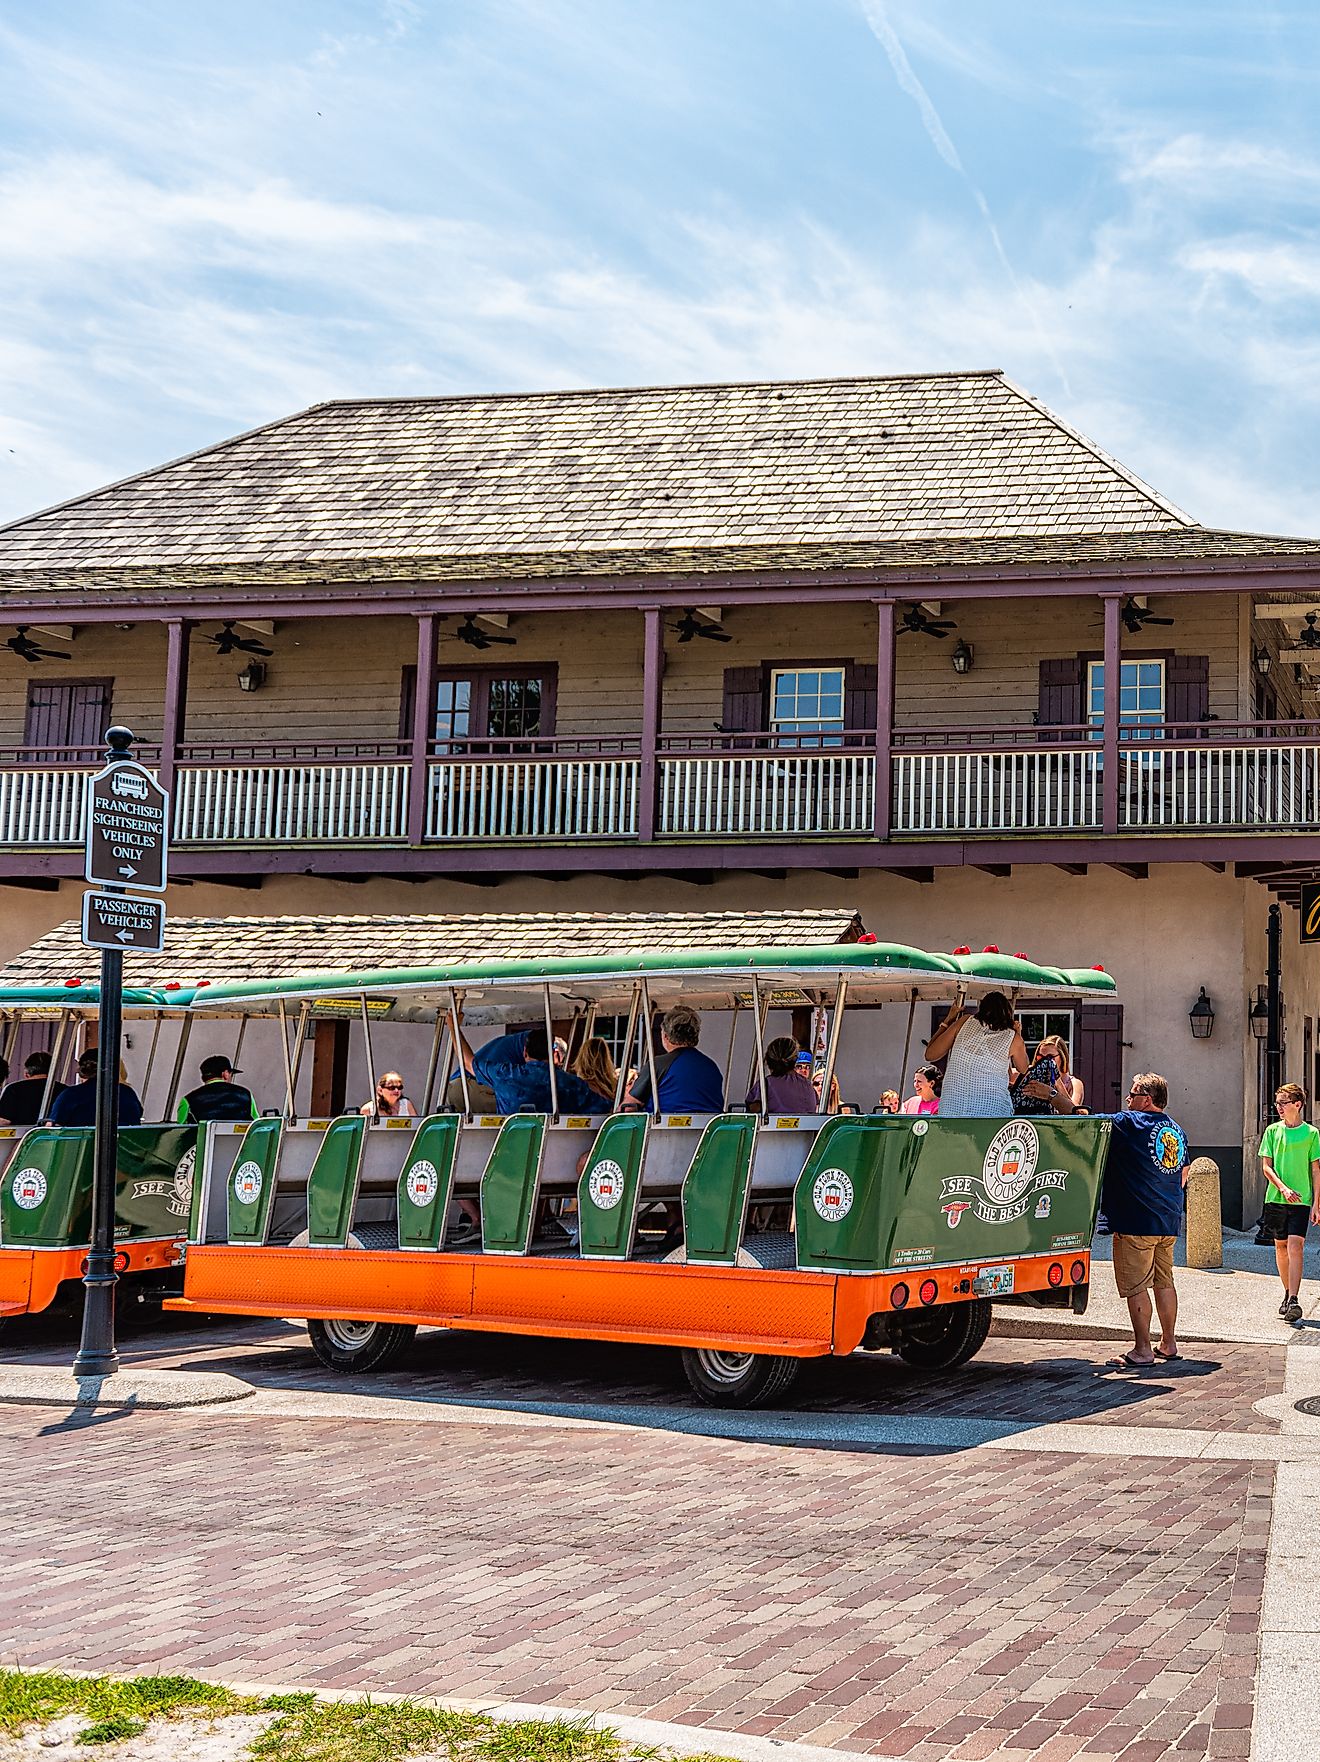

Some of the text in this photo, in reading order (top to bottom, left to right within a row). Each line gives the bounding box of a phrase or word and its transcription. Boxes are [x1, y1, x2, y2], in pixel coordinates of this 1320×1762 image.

[95, 797, 162, 819] FRANCHISED
[93, 812, 163, 834] SIGHTSEEING
[101, 828, 155, 848] VEHICLES
[112, 846, 143, 861] ONLY
[94, 898, 157, 917] PASSENGER
[98, 913, 153, 930] VEHICLES
[987, 1124, 1035, 1169] OLD TOWN TROLLEY
[177, 1162, 188, 1181] OLD
[1034, 1172, 1065, 1189] FIRST
[139, 1183, 164, 1195] SEE
[814, 1171, 852, 1202] OLD TOWN TROLLEY
[947, 1178, 972, 1192] SEE
[990, 1176, 1028, 1199] TOURS
[170, 1201, 191, 1214] THE
[593, 1195, 618, 1208] TOURS
[978, 1200, 997, 1221] THE
[999, 1198, 1029, 1221] BEST
[818, 1204, 847, 1220] TOURS
